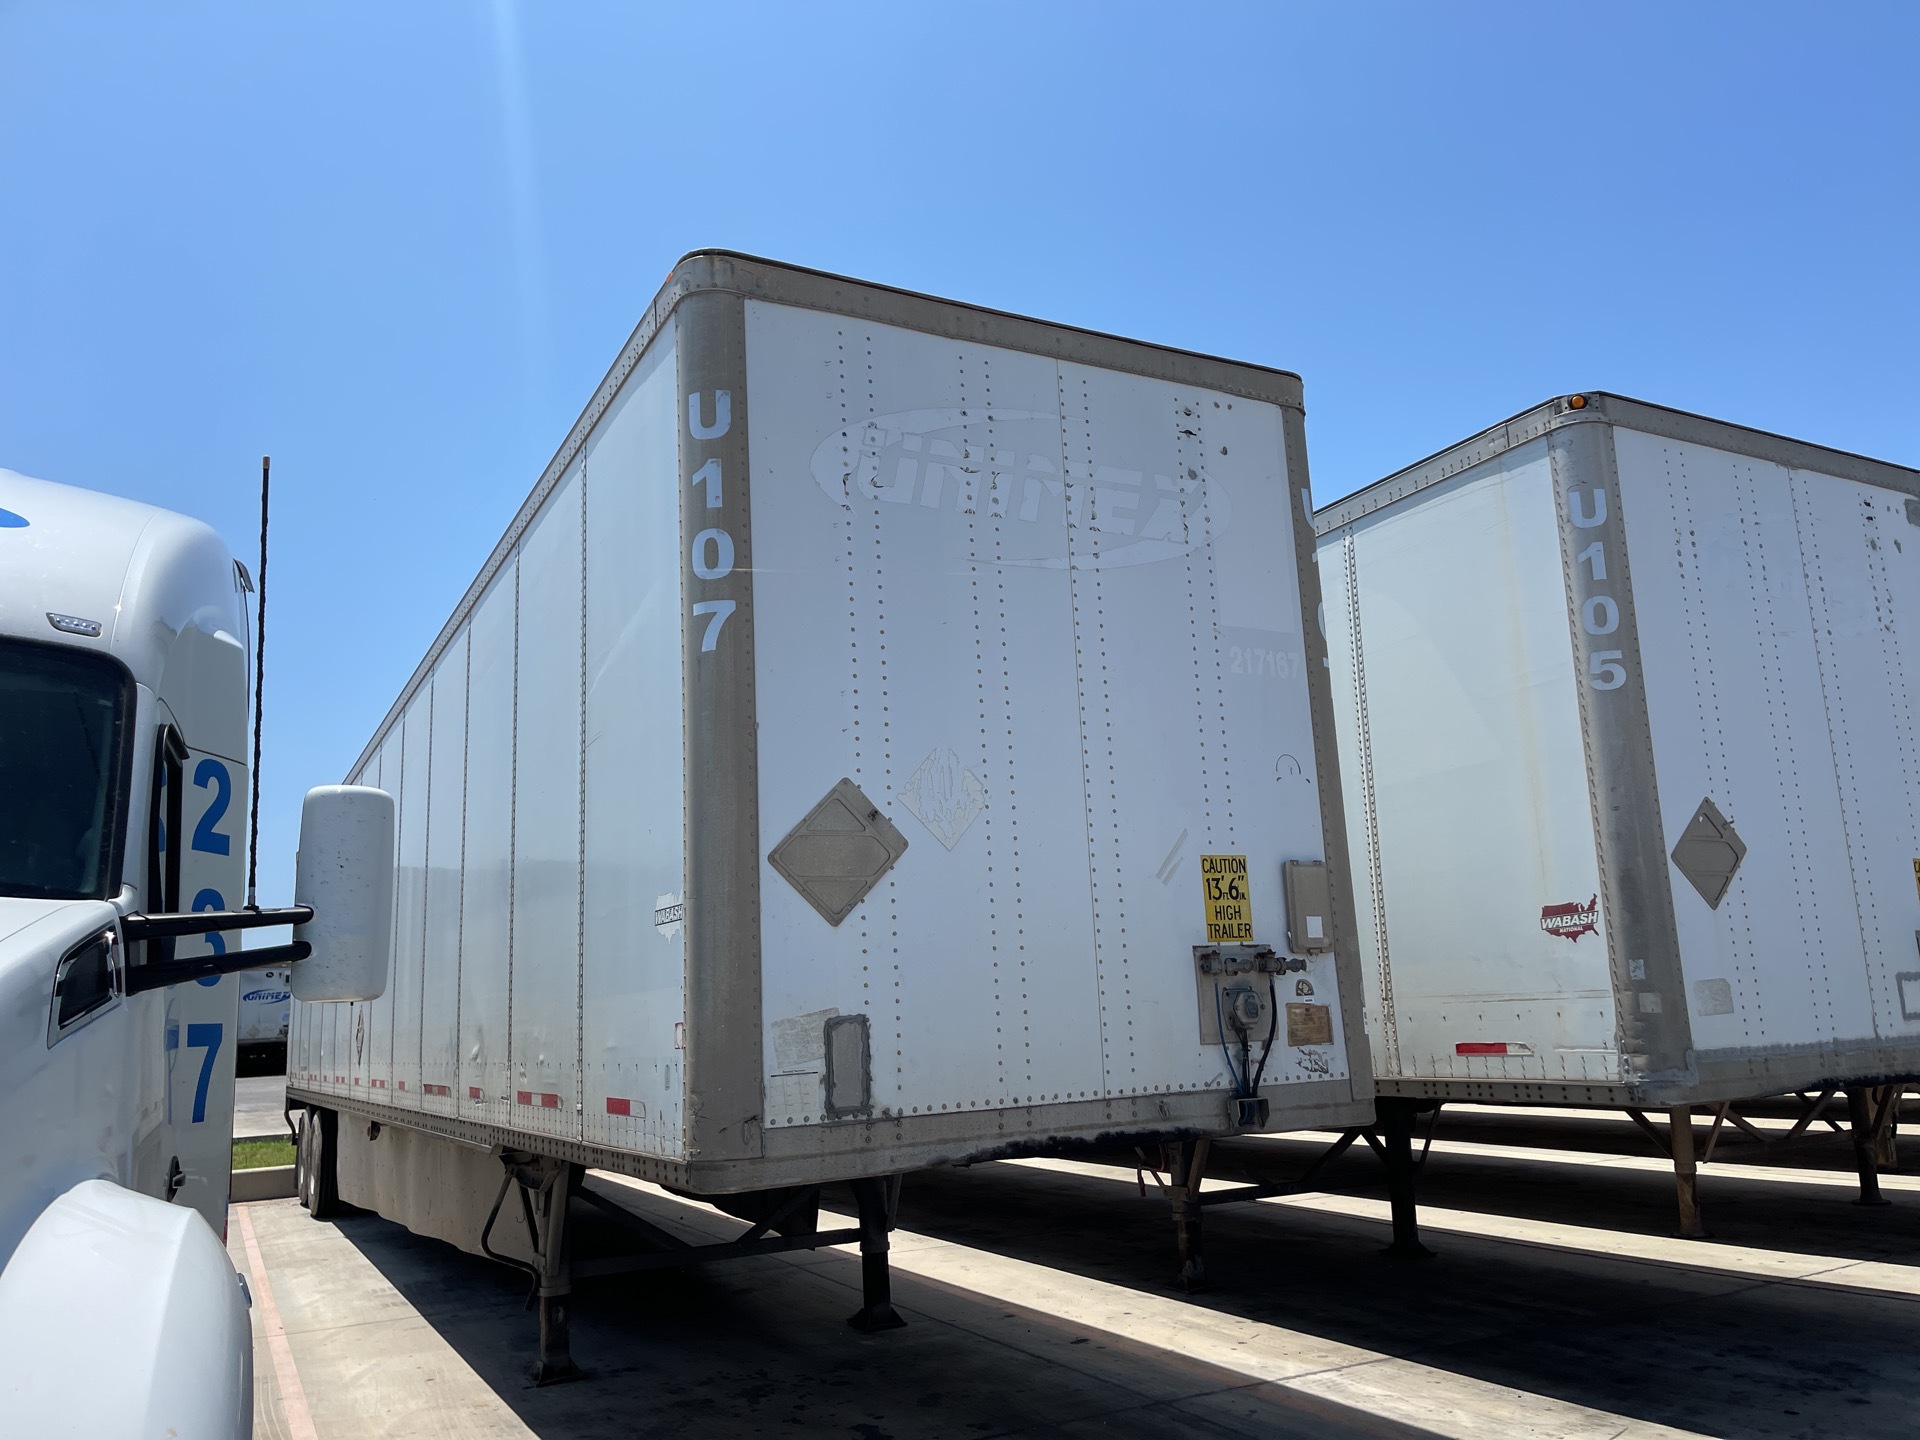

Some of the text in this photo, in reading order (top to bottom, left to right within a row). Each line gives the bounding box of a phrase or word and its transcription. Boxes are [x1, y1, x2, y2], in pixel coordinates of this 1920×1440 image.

[1202, 858, 1246, 874] CAUTION
[655, 905, 683, 924] WABASH
[1214, 905, 1242, 920] HIGH
[1541, 911, 1598, 930] WABASH
[1207, 923, 1252, 939] TRAILER
